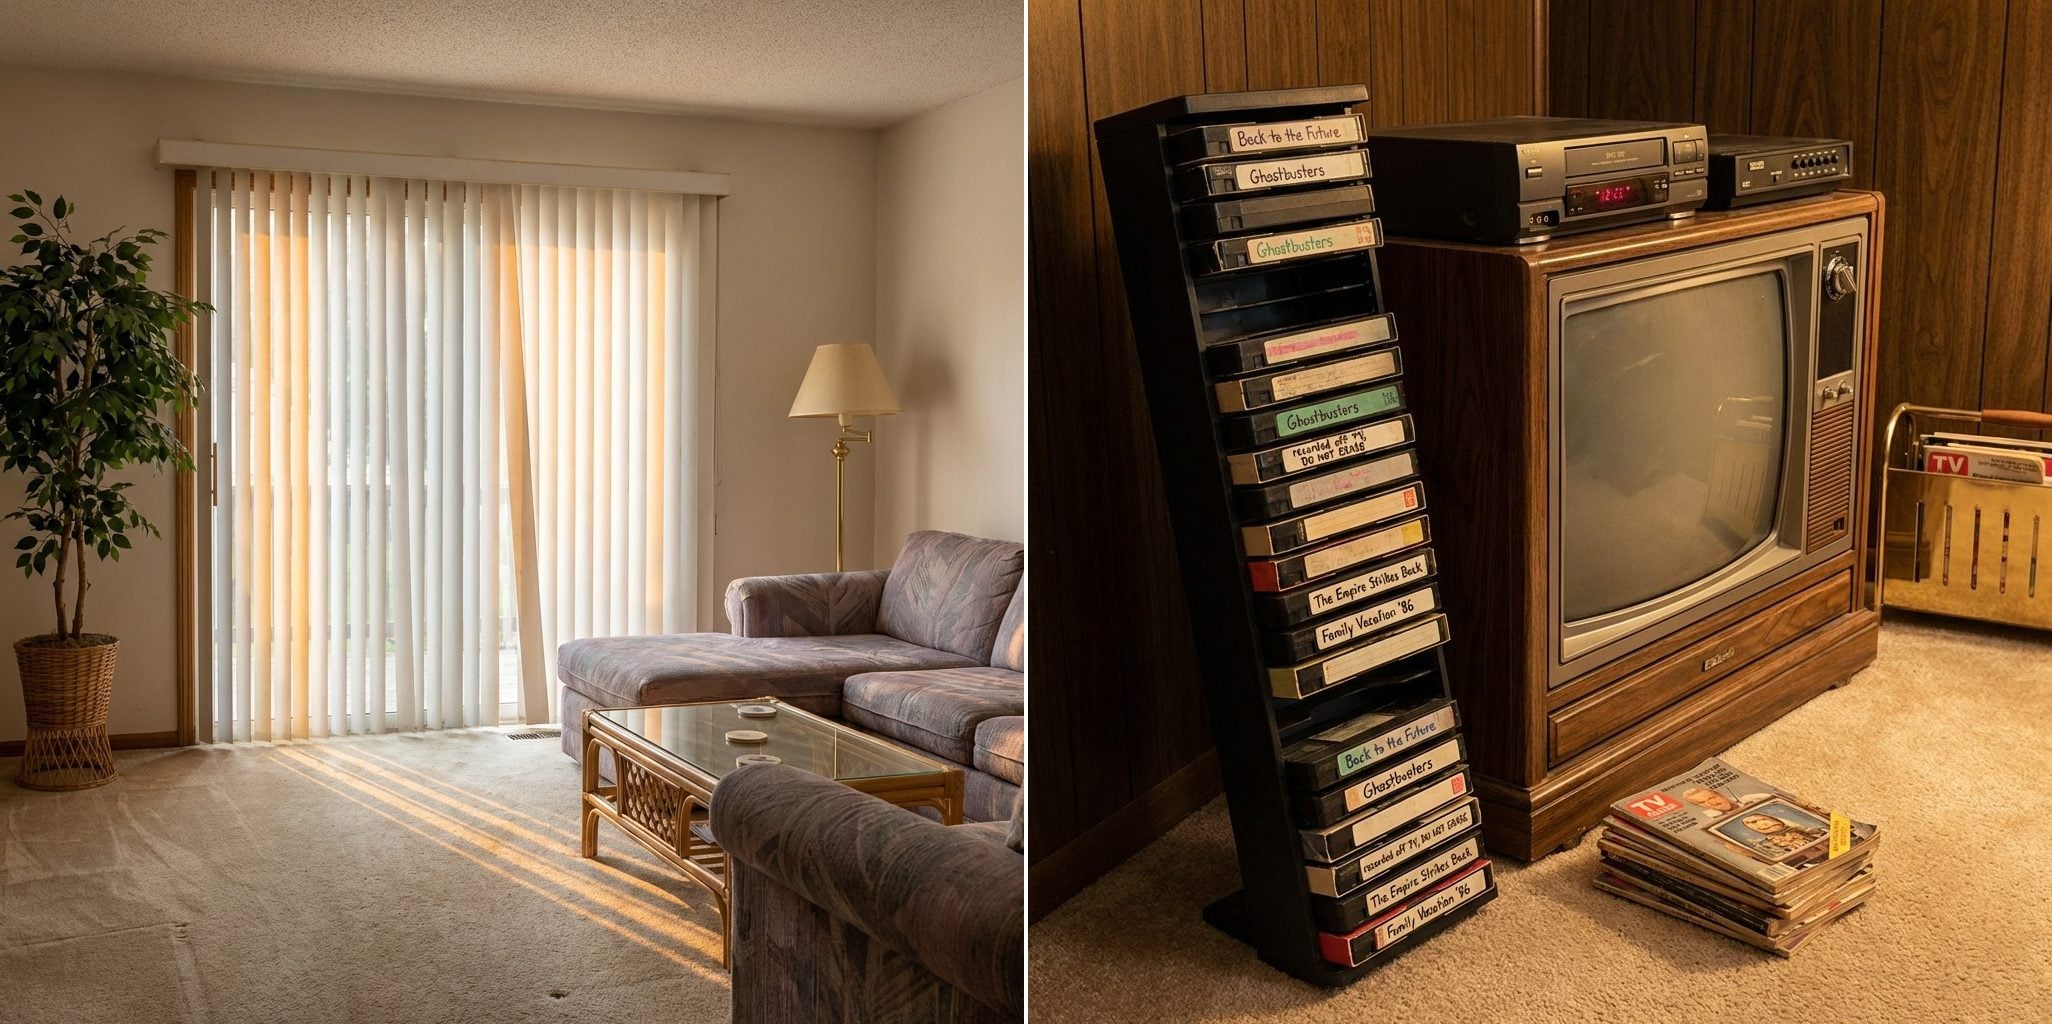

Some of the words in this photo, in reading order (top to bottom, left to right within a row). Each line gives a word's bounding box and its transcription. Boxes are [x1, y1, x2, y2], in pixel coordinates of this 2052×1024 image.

[1269, 129, 1282, 143] to
[1285, 128, 1304, 142] the
[1250, 164, 1326, 184] Ghostbusters
[1256, 236, 1334, 258] Ghostbusters
[1287, 403, 1360, 430] Ghostbusters
[1301, 456, 1314, 466] DO
[1933, 455, 1965, 474] TV
[1313, 593, 1334, 609] The
[1374, 743, 1385, 755] to
[1405, 722, 1437, 742] Future
[1630, 794, 1666, 812] TV
